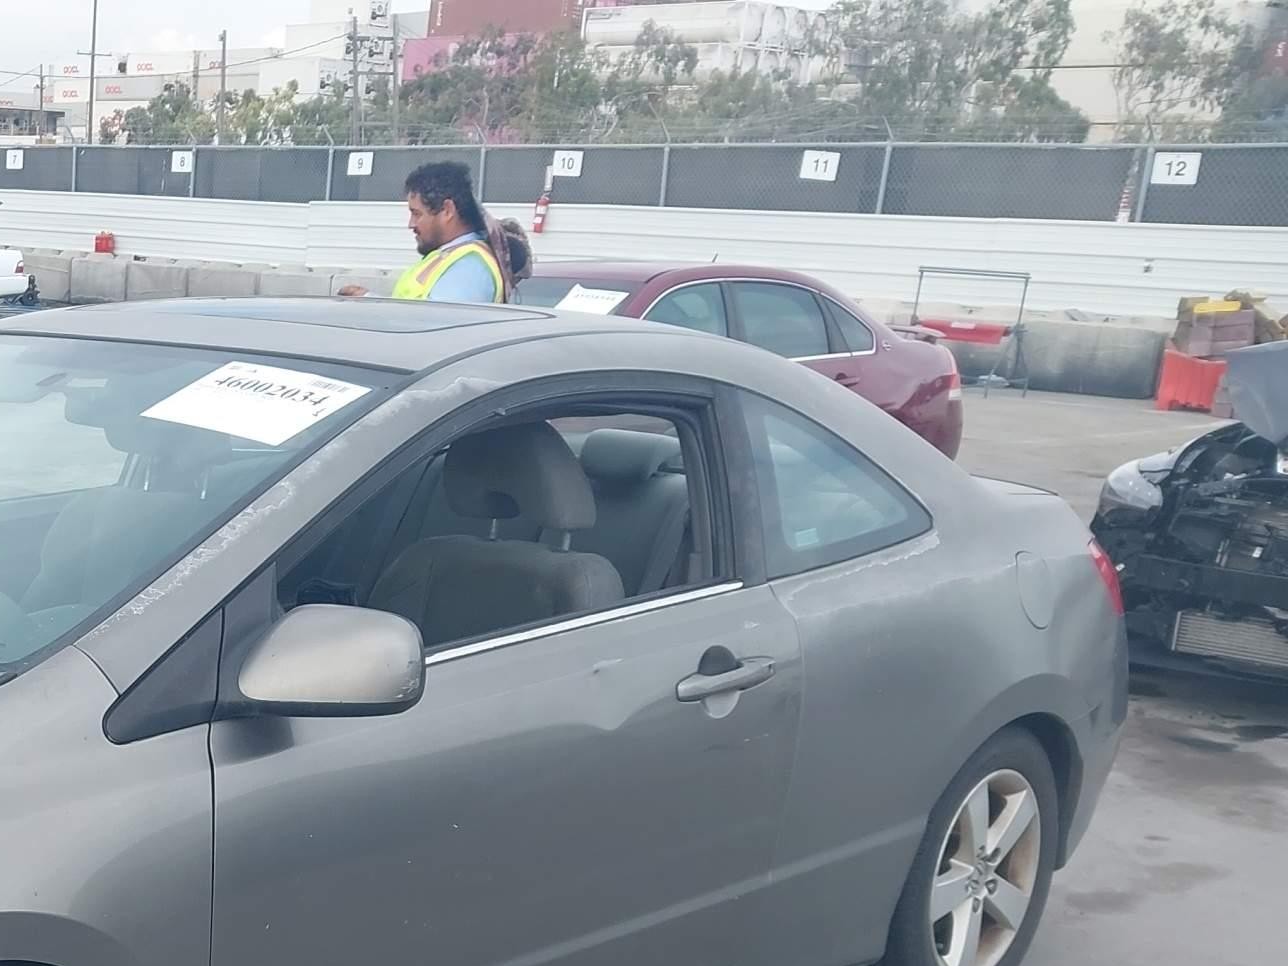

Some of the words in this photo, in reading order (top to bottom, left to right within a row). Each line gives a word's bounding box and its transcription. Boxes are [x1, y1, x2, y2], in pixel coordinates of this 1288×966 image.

[12, 154, 18, 165] 7
[179, 156, 185, 168] 8
[357, 159, 363, 169] 9
[560, 158, 574, 170] 10
[812, 158, 829, 174] 11
[1165, 160, 1187, 176] 12
[215, 376, 330, 406] 46002034
